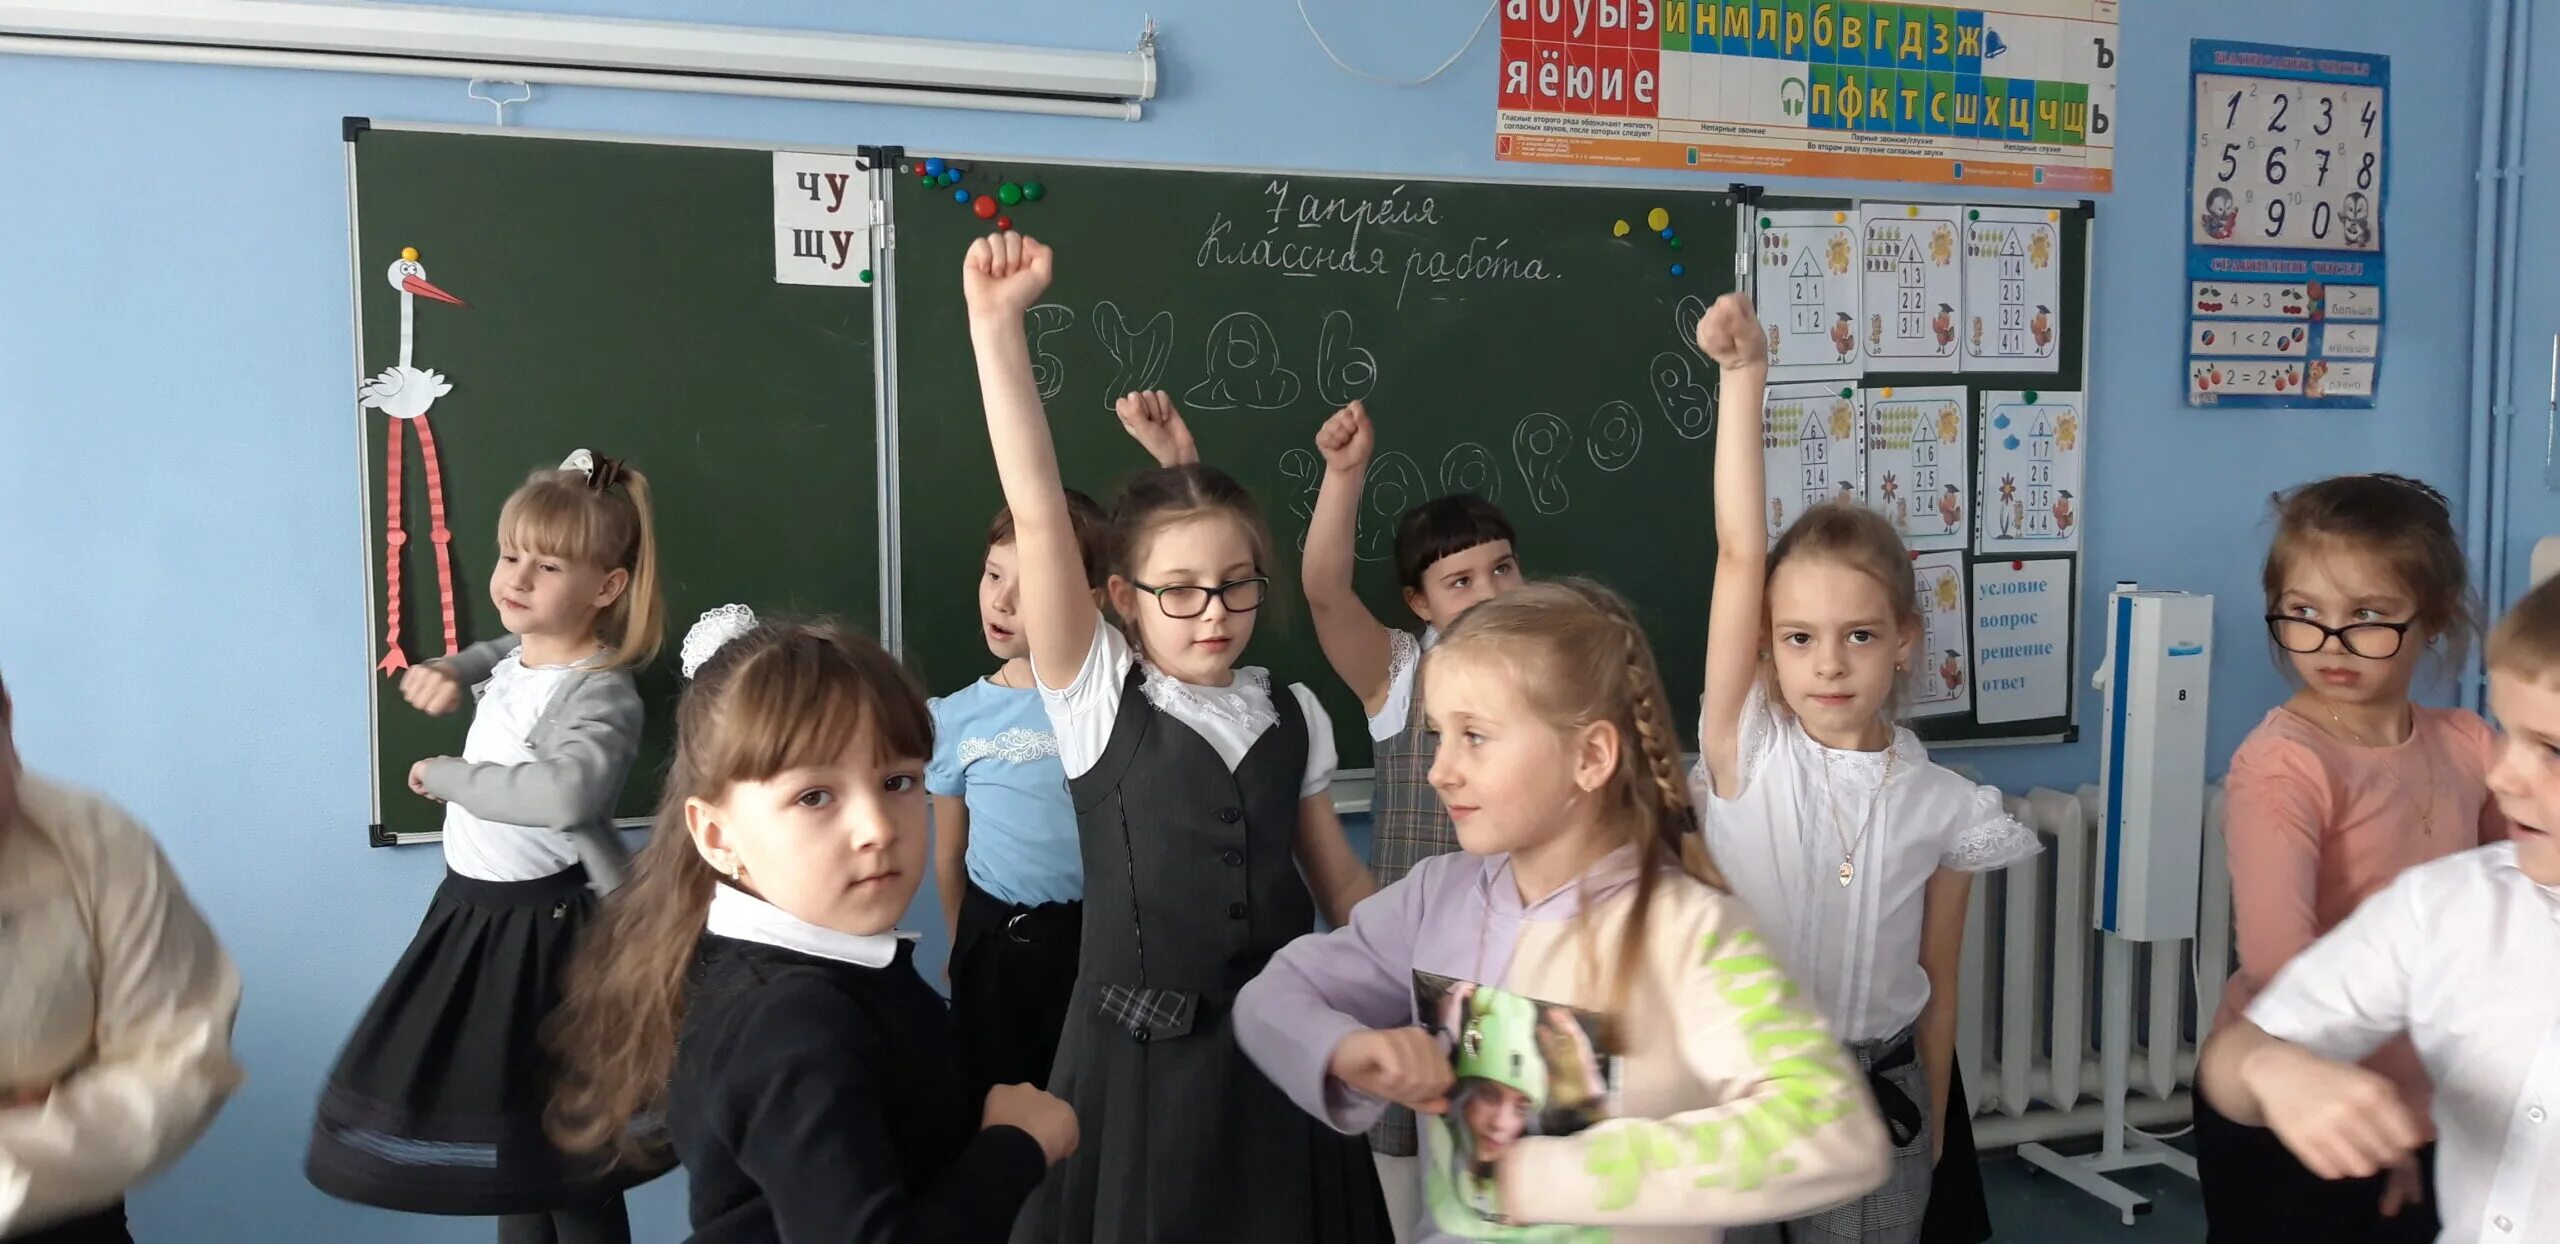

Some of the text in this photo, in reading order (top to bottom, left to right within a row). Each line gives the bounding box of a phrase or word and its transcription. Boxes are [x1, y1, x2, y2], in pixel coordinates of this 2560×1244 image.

[1501, 113, 1654, 130] Гласные второго ряда обозначают мягкость
[2225, 90, 2377, 138] 1 2 3 4
[1504, 123, 1651, 138] согласных звуков, после которых следуют
[1701, 123, 1766, 135] Непарные звонкие
[2218, 143, 2375, 190] 5 6 7 8
[796, 172, 849, 213] чу
[1264, 180, 1289, 223] 7
[2265, 199, 2331, 239] 9 0
[793, 229, 854, 270] щу
[2230, 293, 2239, 306] 4
[2263, 293, 2271, 308] 3
[2232, 331, 2237, 345] 1
[2262, 331, 2271, 346] 2
[2226, 369, 2235, 384] 2
[2257, 370, 2267, 385] 2
[1980, 578, 2048, 601] условие
[1980, 612, 2038, 631] вопрос
[1981, 641, 2053, 665] решение
[1982, 676, 2025, 692] ответ
[2179, 689, 2186, 701] 8
